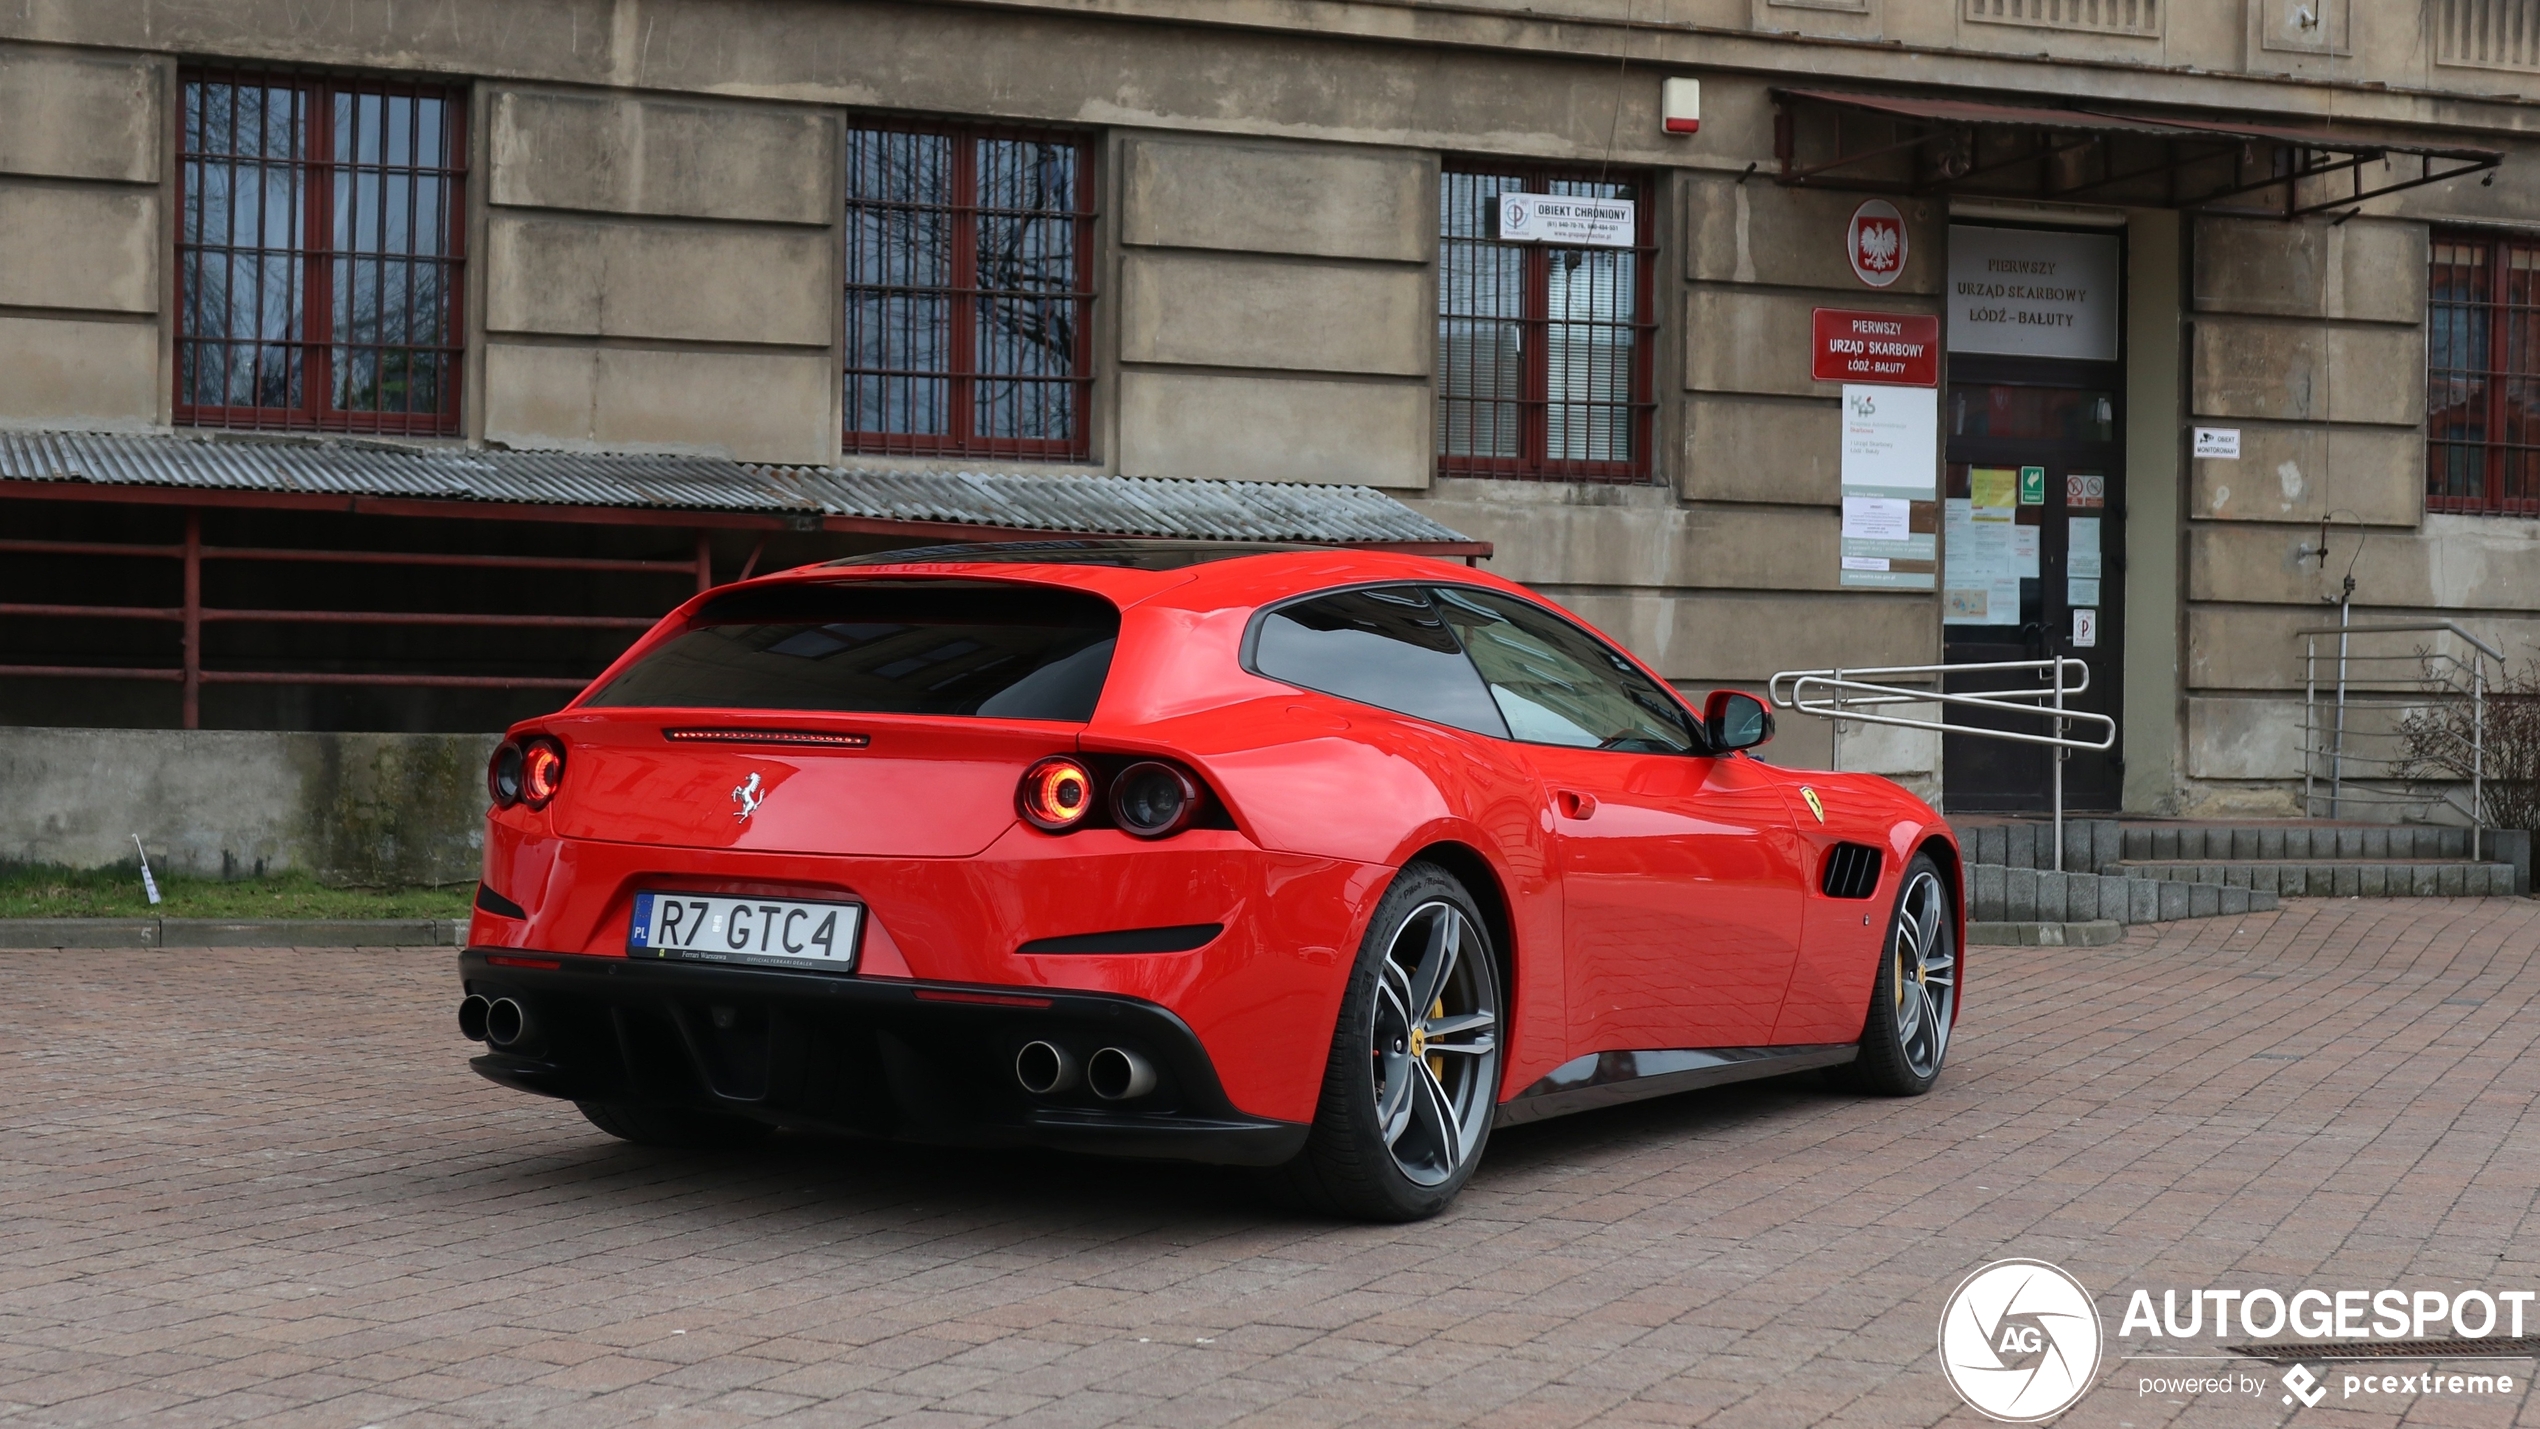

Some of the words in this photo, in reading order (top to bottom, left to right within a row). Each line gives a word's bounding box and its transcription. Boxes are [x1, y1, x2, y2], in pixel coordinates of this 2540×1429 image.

[1538, 204, 1571, 216] OBIEKT
[1574, 206, 1626, 220] CHRONIONY
[1988, 259, 2056, 275] PIERWSZY
[1957, 282, 2005, 299] URZĄD
[2008, 285, 2087, 302] SKARBOWY
[1852, 319, 1902, 335] PIERWSZY
[2018, 311, 2074, 327] BAŁUTY
[1829, 338, 1864, 357] URZĄD
[1868, 341, 1924, 358] SKARBOWY
[1874, 361, 1906, 375] BAŁUTY
[2197, 446, 2237, 454] MONITOROWANY
[1403, 881, 1422, 900] Pilot
[634, 926, 647, 939] PL
[658, 900, 709, 947] R7
[726, 904, 838, 957] GTC4
[681, 950, 700, 960] Ferrari
[700, 951, 727, 961] Warszawa
